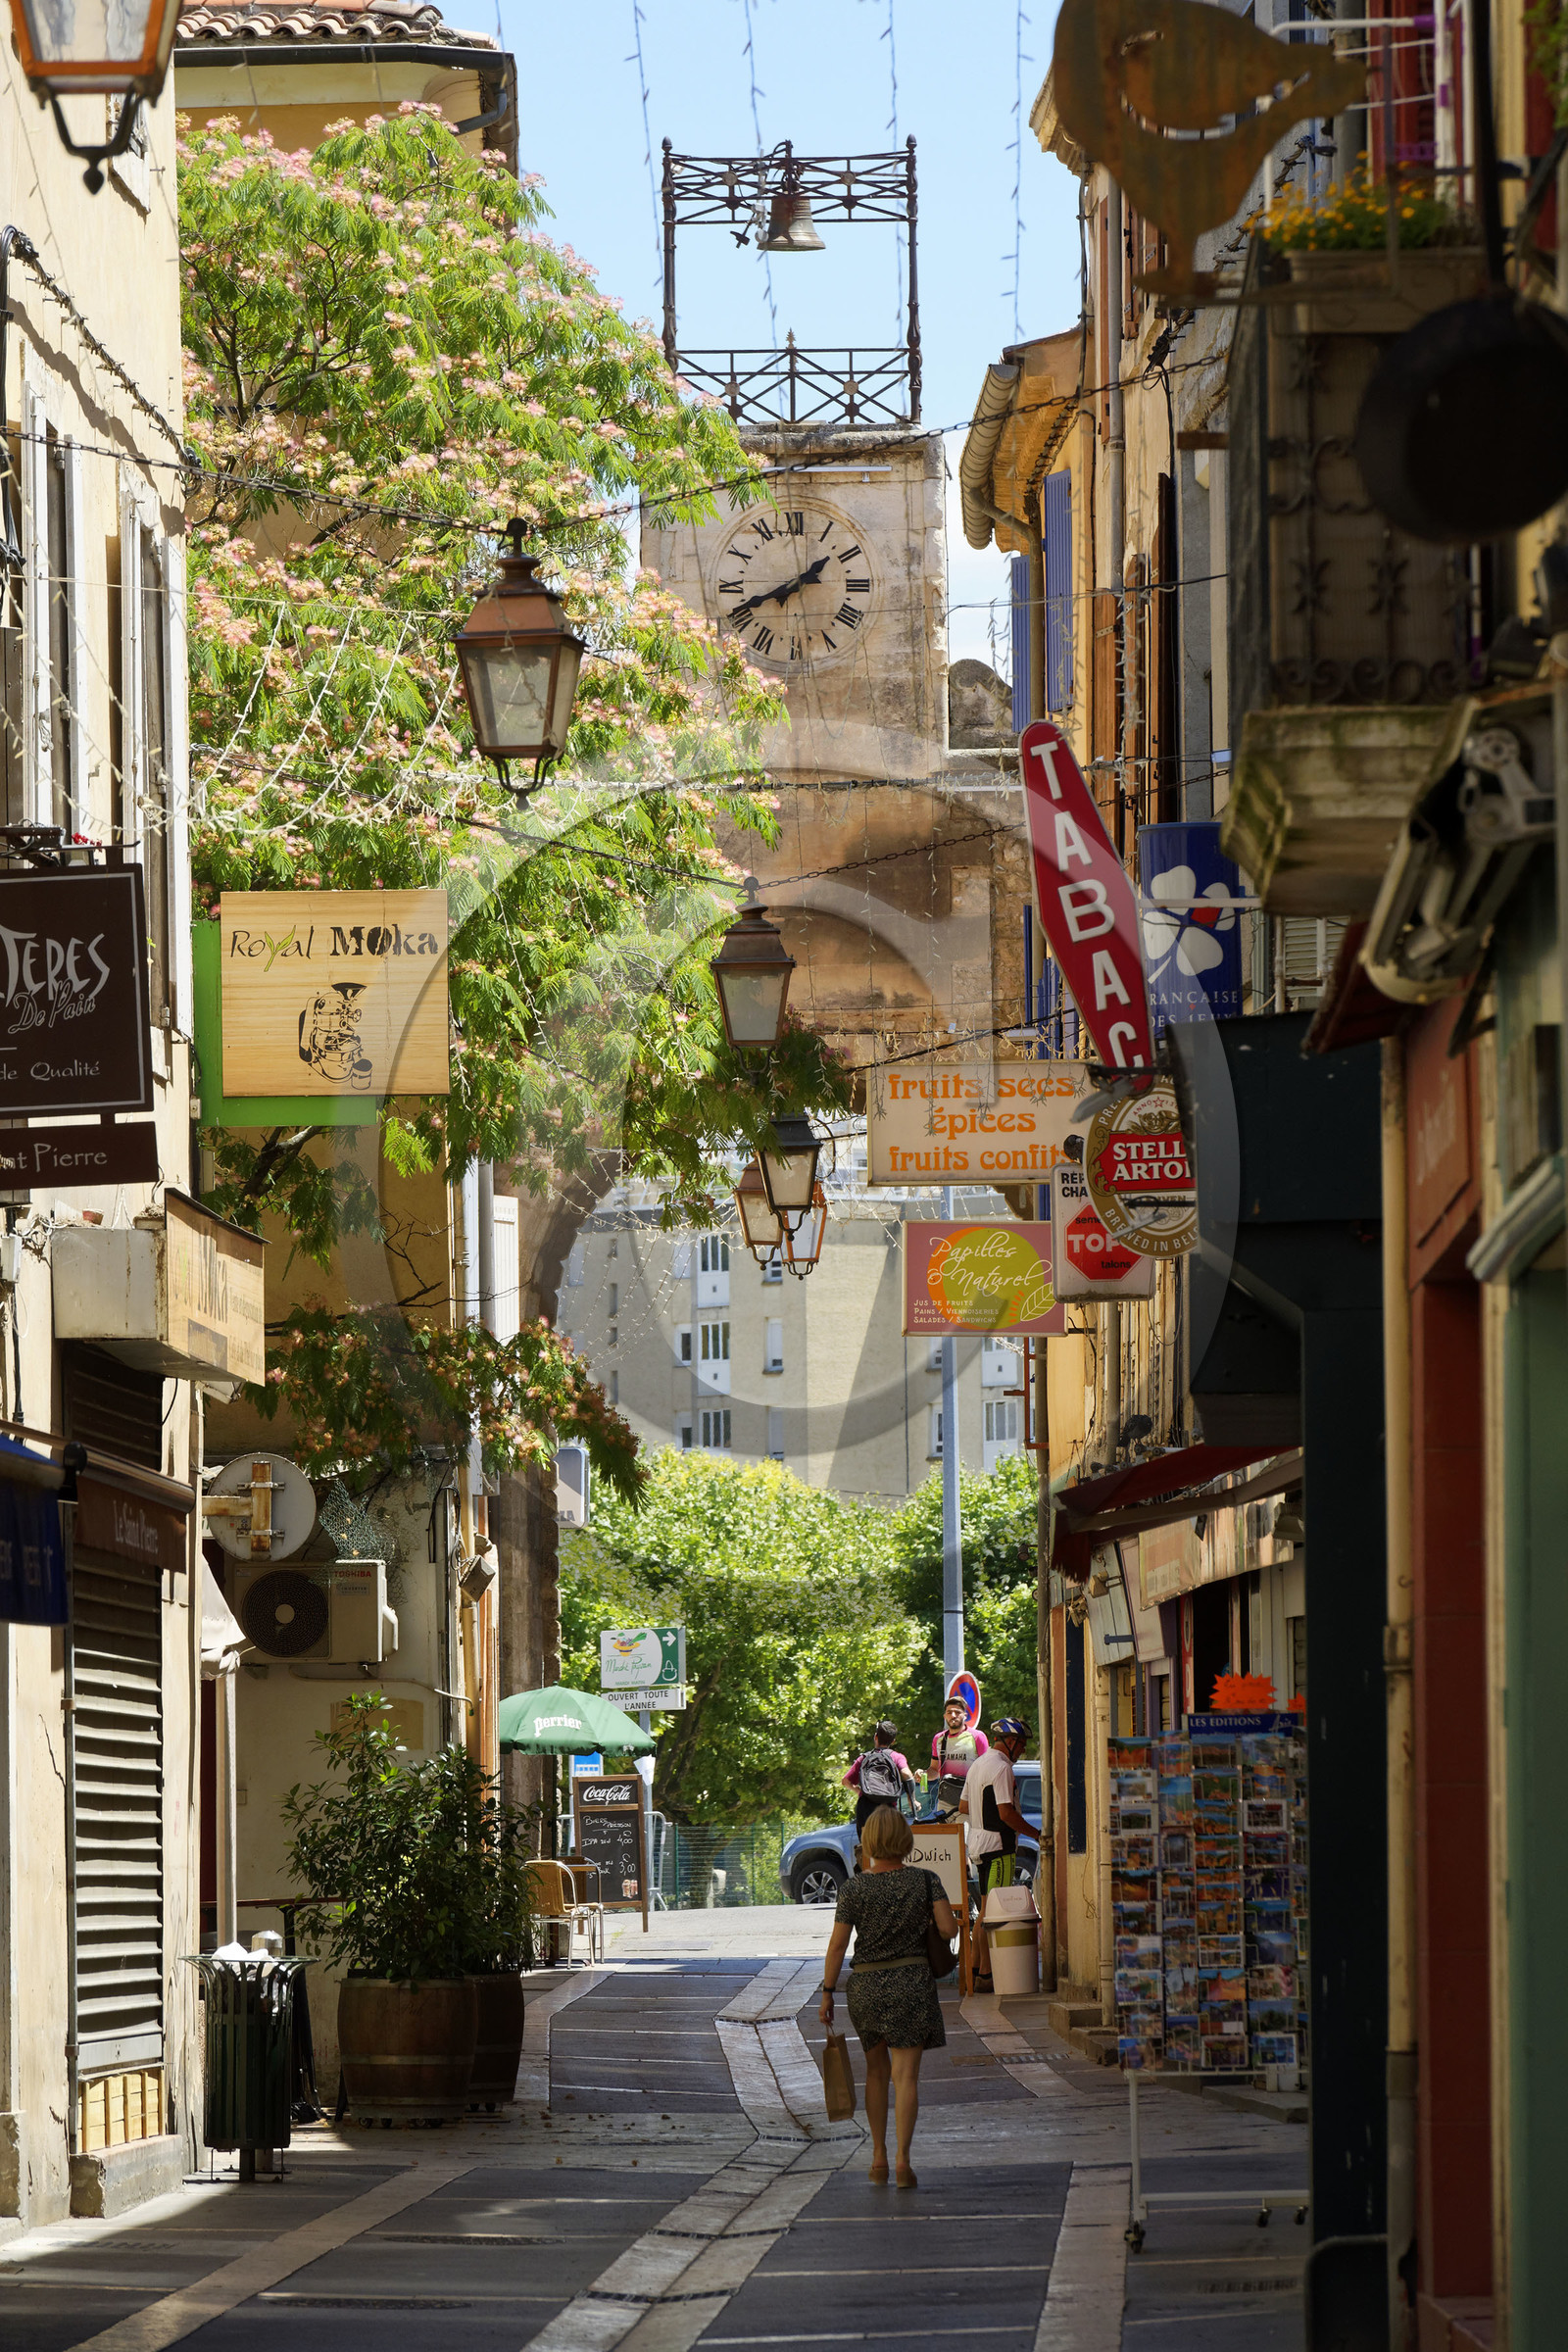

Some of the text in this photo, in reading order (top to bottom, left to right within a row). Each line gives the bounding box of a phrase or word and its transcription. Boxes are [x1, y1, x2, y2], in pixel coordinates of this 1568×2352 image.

[1030, 741, 1145, 1070] TABAC
[229, 924, 315, 972] Royal
[48, 978, 96, 1028] Pain
[30, 1058, 100, 1081] Qualité
[888, 1074, 1075, 1100] fruits secs
[930, 1107, 1036, 1140] épices
[33, 1143, 108, 1173] Pierre
[889, 1146, 970, 1172] fruits
[1113, 1140, 1187, 1160] STELL
[1062, 1186, 1088, 1198] CHA
[930, 1232, 1017, 1270] Papilles
[1068, 1234, 1120, 1252] TOP
[1153, 1241, 1169, 1251] IN
[1101, 1260, 1131, 1269] talons
[951, 1259, 1053, 1297] Naturel
[609, 1690, 668, 1701] OUVERT TOUTE
[1190, 1717, 1206, 1727] LES
[583, 1785, 632, 1801] Coca-Cola
